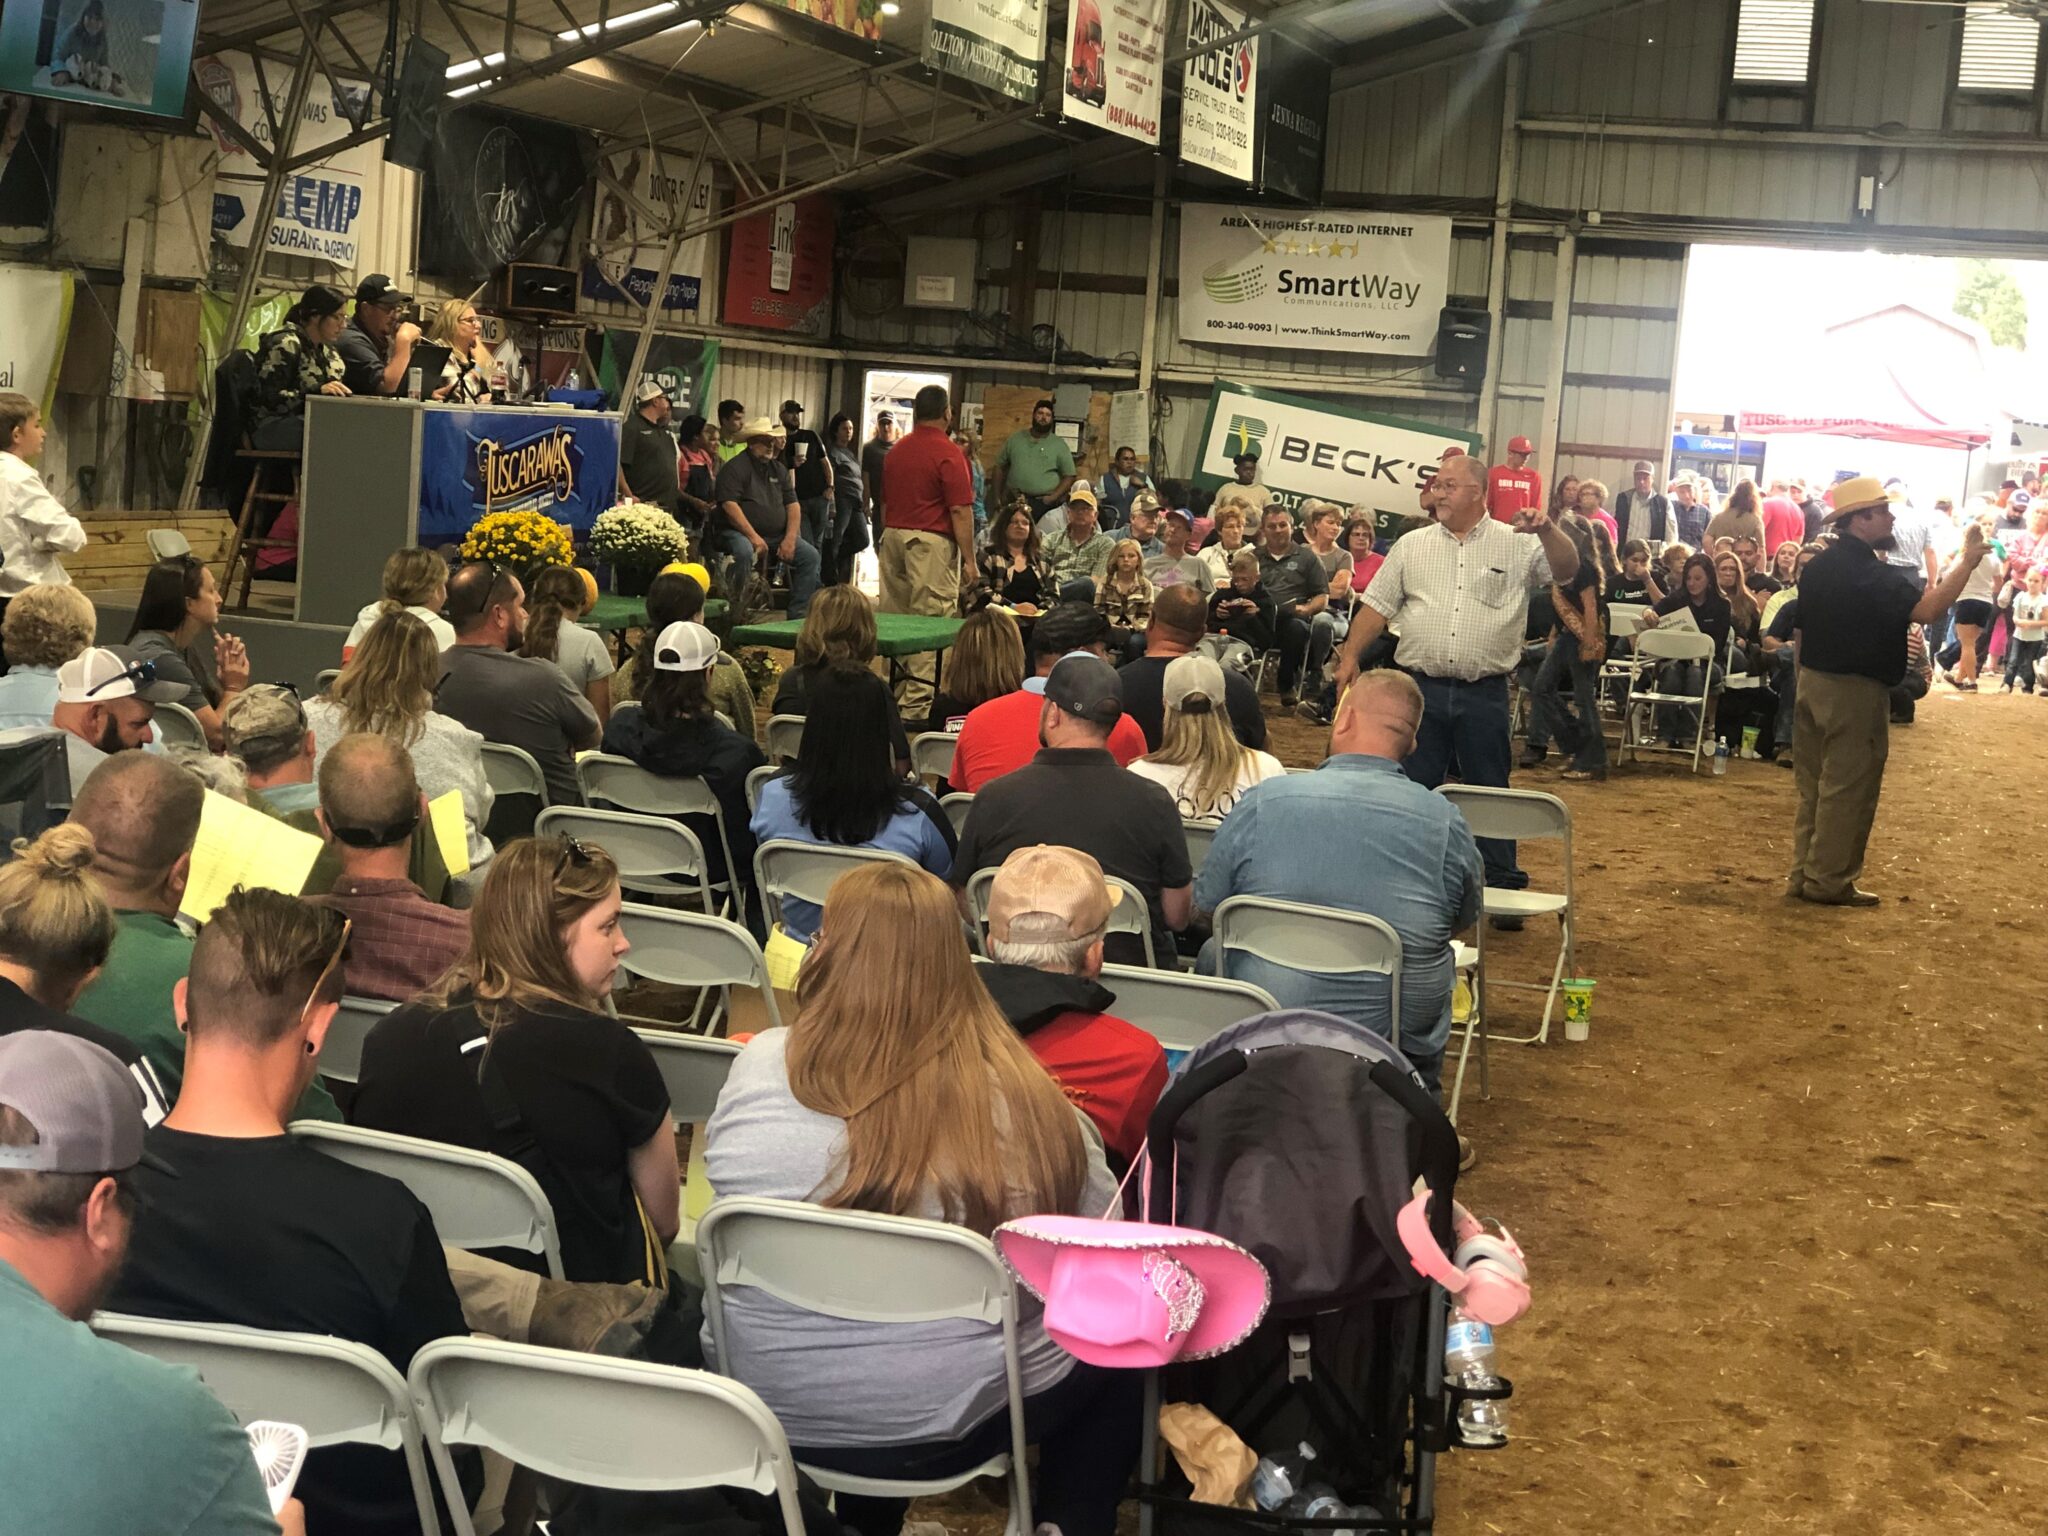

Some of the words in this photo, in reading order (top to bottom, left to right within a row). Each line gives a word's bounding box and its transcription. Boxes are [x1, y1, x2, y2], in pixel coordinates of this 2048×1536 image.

[1220, 217, 1260, 229] AREA'S
[1263, 219, 1354, 235] HIGHEST-RATED
[1356, 225, 1414, 238] INTERNET
[324, 238, 355, 260] AGENCY
[1277, 269, 1421, 308] SmartWay
[1283, 296, 1377, 310] Communications,
[1381, 302, 1399, 311] LLC
[1206, 319, 1272, 332] 800-340-9093
[1281, 326, 1411, 341] www.ThinkSmartWay.com
[476, 424, 572, 514] TUSCARAWAS
[1281, 435, 1442, 489] BECK'S
